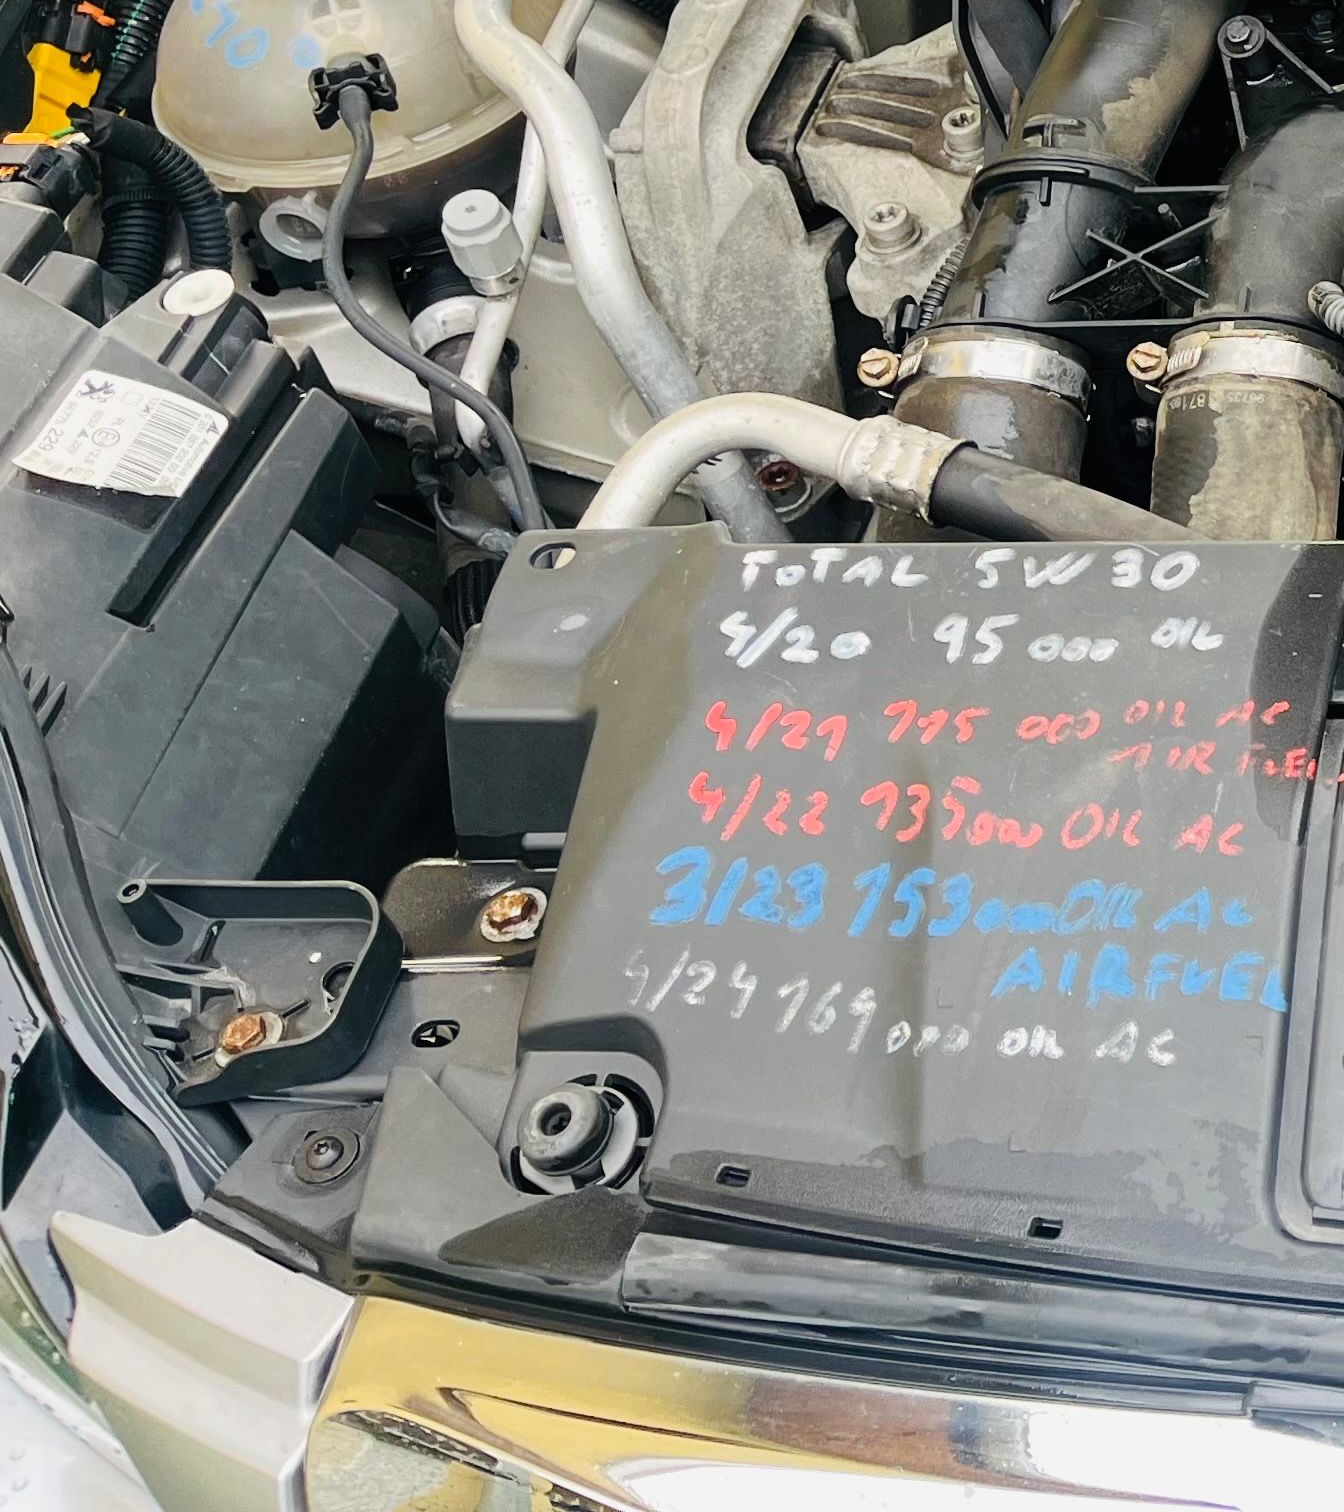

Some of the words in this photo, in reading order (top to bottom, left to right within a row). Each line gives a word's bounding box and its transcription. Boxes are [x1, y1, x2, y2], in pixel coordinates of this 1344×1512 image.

[39, 427, 64, 452] 229
[720, 607, 871, 668] 4/20
[934, 614, 1019, 664] 95
[1151, 617, 1224, 650] OIL
[705, 701, 848, 760] 4/21
[885, 700, 986, 743] 115
[1128, 702, 1185, 725] OIL
[689, 771, 828, 839] 4/22
[1062, 805, 1140, 849] OIL
[1181, 817, 1242, 855] AC
[651, 846, 827, 929] 3/23
[997, 1025, 1064, 1059] OIL
[1095, 1022, 1176, 1066] AC
